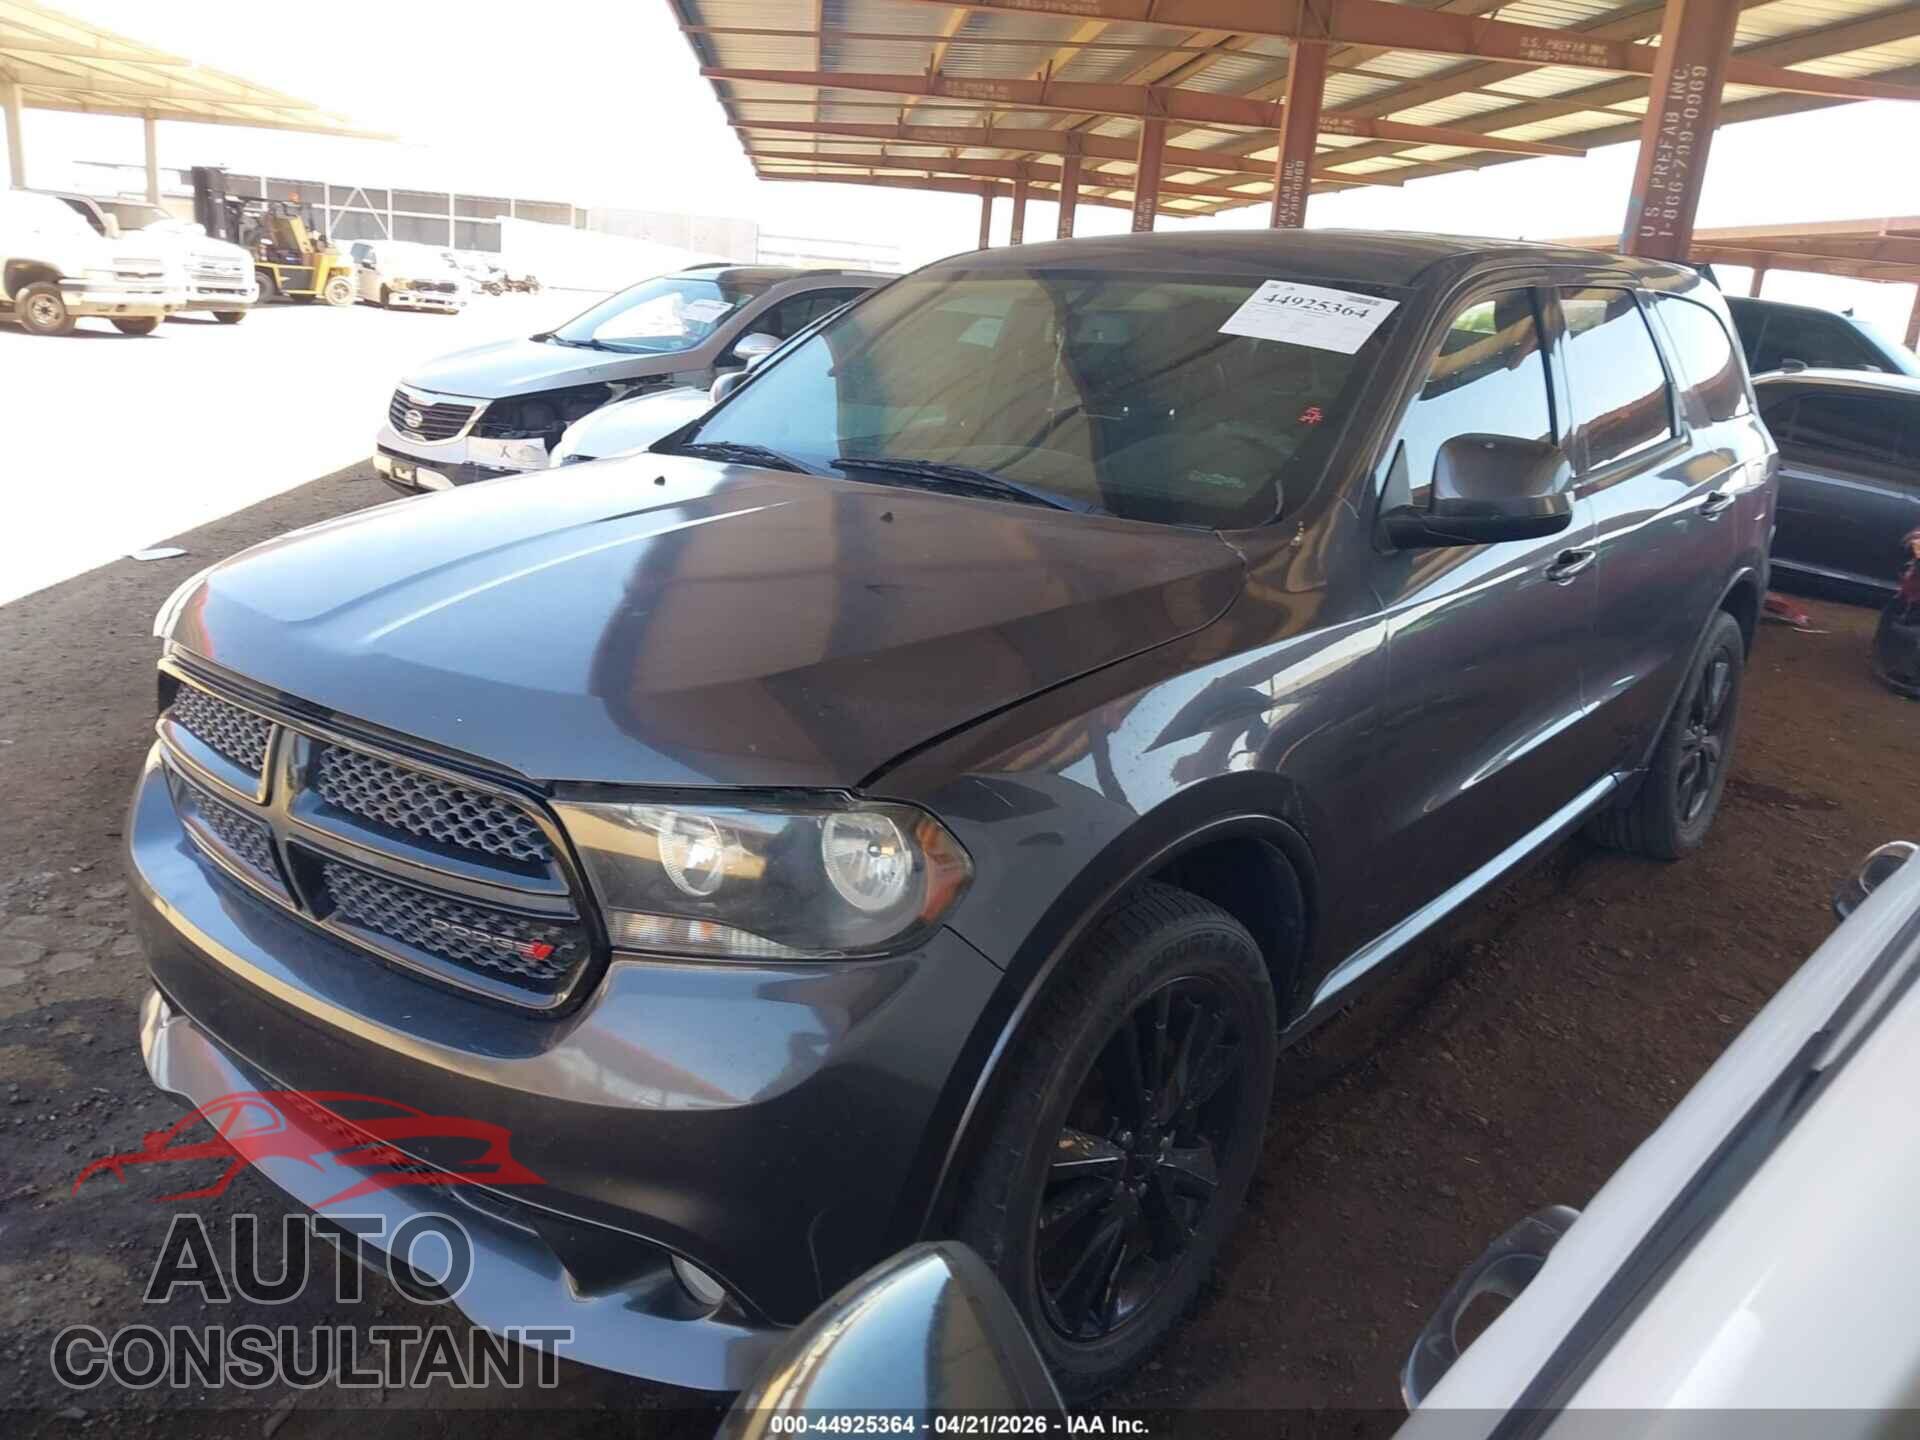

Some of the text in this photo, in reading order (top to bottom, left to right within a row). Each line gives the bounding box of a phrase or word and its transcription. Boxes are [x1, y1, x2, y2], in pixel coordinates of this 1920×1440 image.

[1651, 112, 1680, 189] PREFAB
[1658, 65, 1708, 237] 1-866-799-0969
[1264, 294, 1370, 318] 44925364
